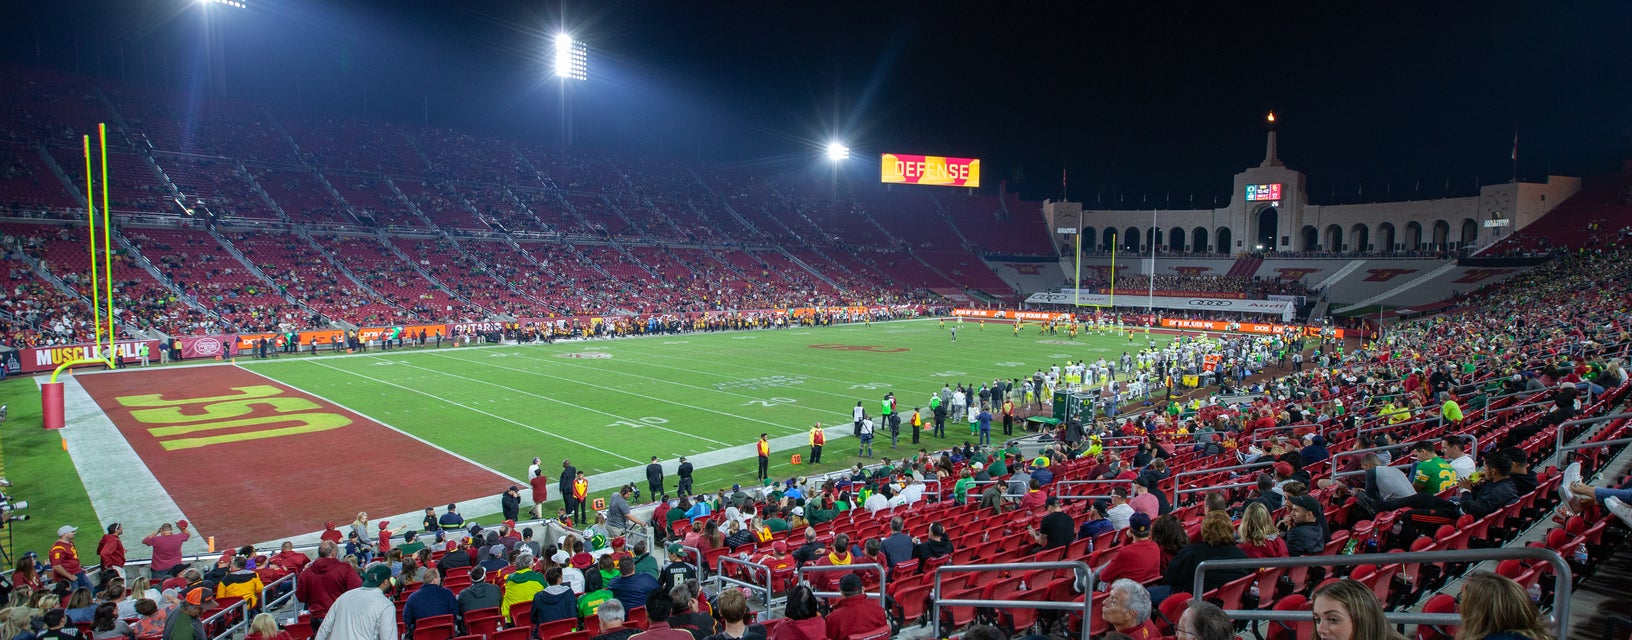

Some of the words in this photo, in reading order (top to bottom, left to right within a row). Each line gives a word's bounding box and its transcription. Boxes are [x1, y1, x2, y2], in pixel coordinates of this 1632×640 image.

[895, 161, 969, 180] DEFENSE
[36, 344, 101, 366] MUSCLE
[114, 384, 353, 451] USC
[603, 416, 669, 428] 10
[595, 499, 604, 509] G
